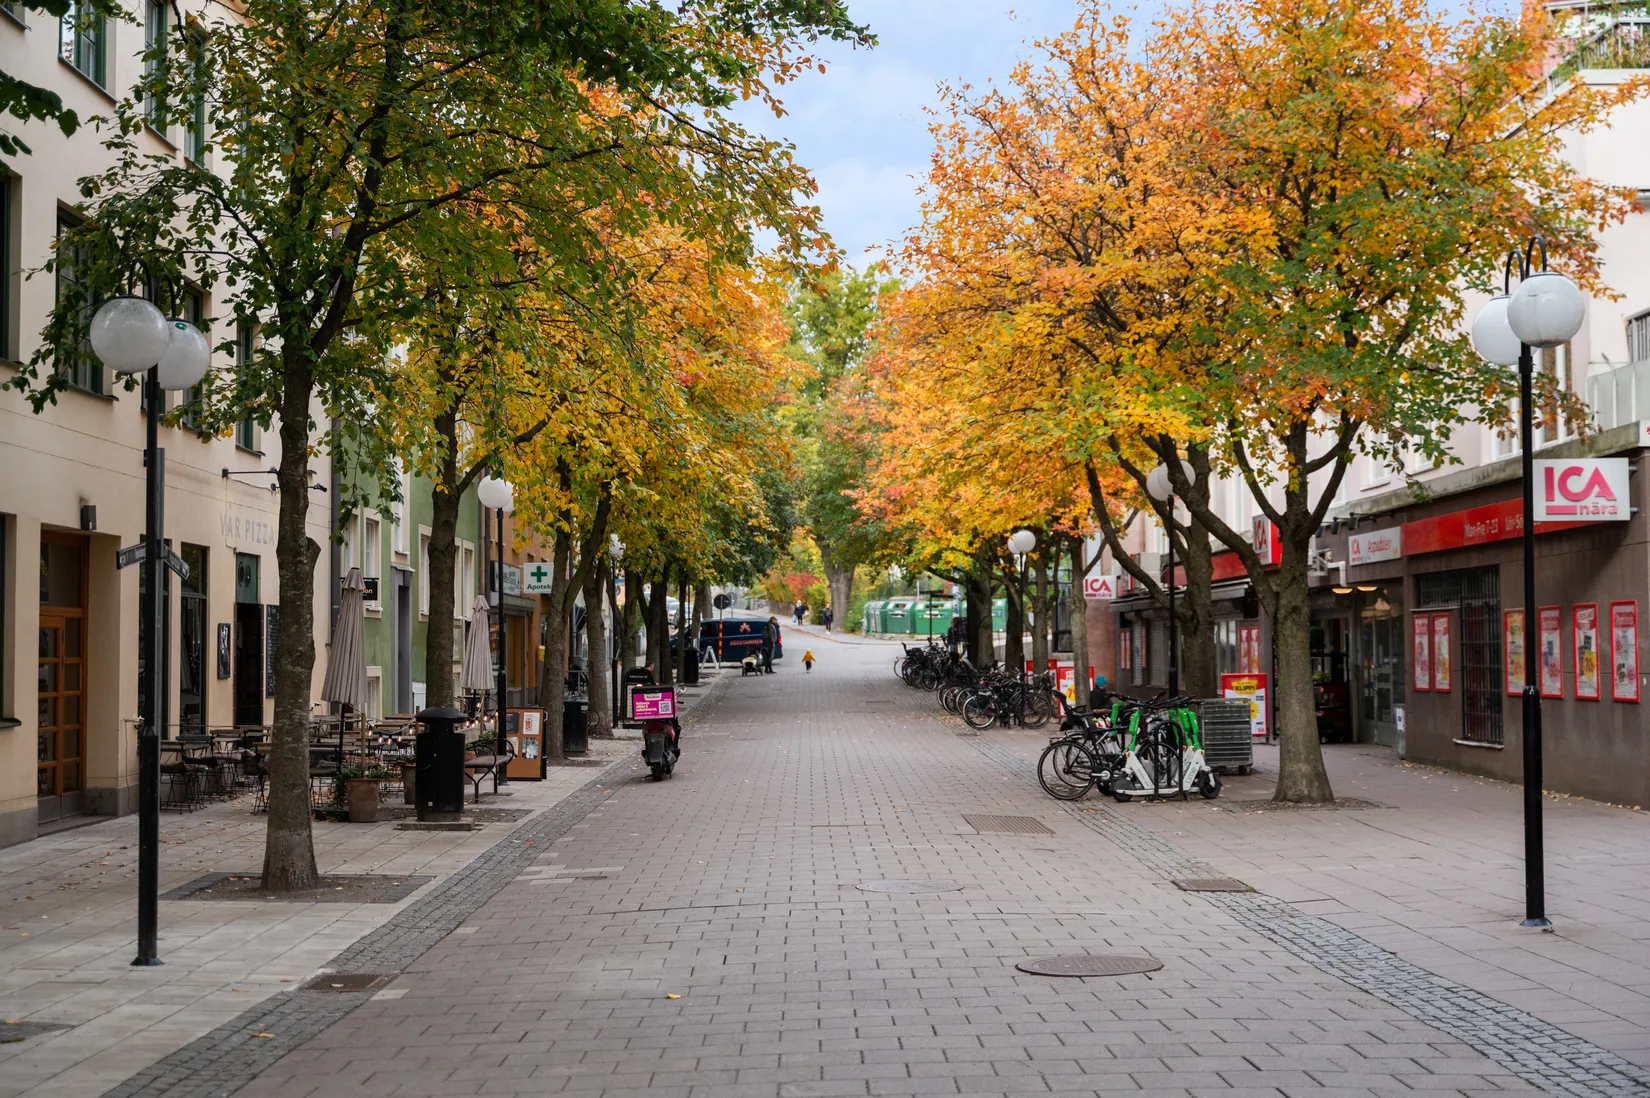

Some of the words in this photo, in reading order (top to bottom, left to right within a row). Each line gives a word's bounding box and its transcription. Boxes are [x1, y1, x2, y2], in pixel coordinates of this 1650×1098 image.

[1544, 466, 1617, 502] ICA
[1579, 501, 1618, 515] nära
[220, 504, 240, 539] VÅR
[245, 518, 275, 546] PIZZA
[1254, 519, 1268, 552] ICA
[527, 583, 552, 591] Apotek
[1085, 578, 1112, 592] ICA
